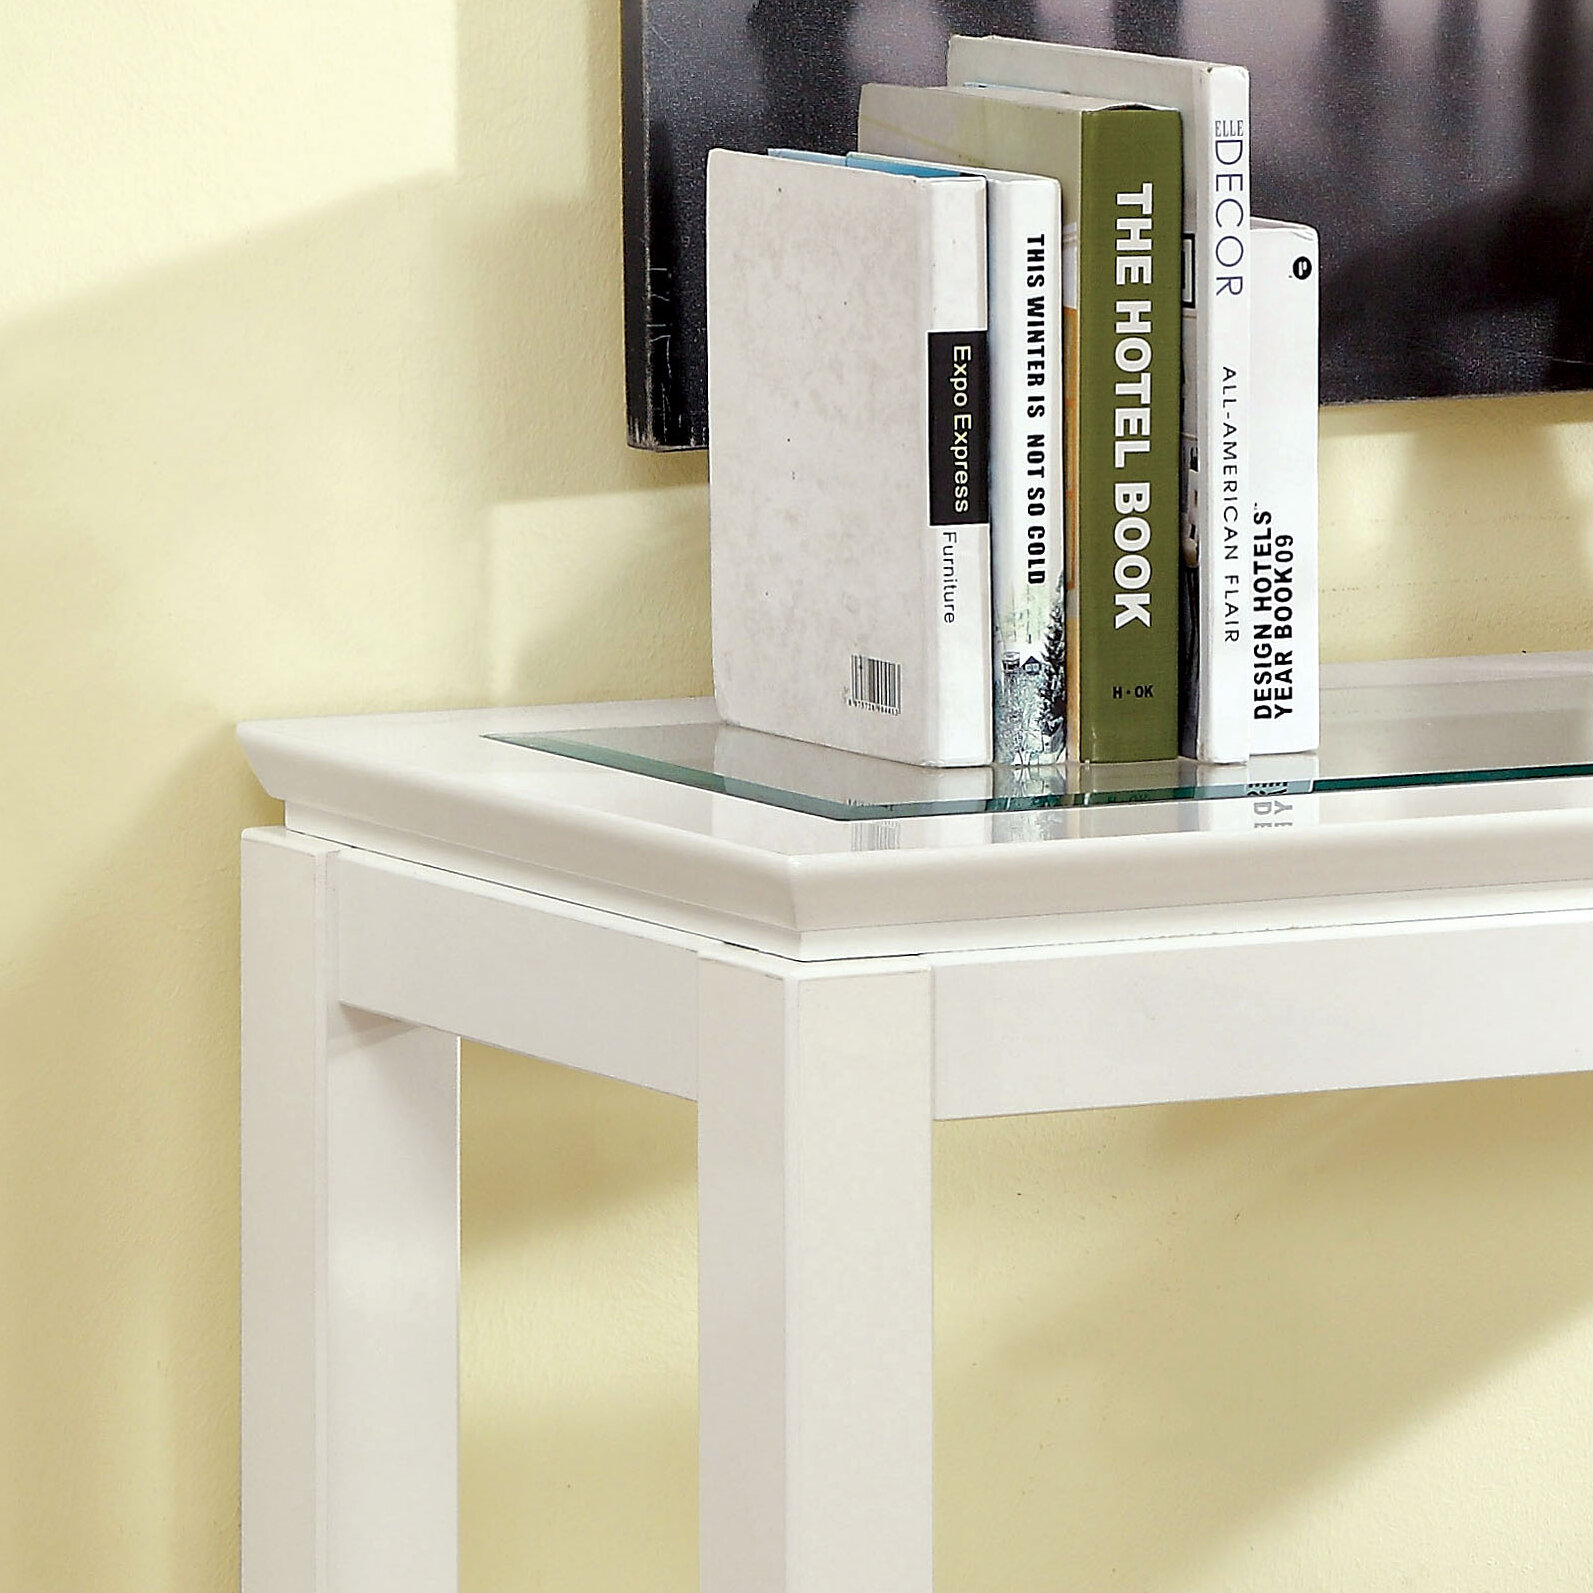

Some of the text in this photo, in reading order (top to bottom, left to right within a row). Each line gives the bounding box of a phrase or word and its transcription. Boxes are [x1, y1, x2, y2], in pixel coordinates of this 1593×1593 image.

[1214, 139, 1244, 296] DECOR
[1215, 119, 1244, 137] ELLE
[949, 345, 972, 513] Expo Express
[1026, 233, 1046, 585] THIS WINTER IS NOT SO COLD
[1114, 183, 1153, 629] THE HOTEL BOOK
[942, 531, 958, 624] Furniture
[1222, 366, 1240, 642] ALL-AMERICAN FLAIR
[1253, 511, 1273, 720] DESIGN HOTELS
[1273, 534, 1294, 720] YEAR BOOK09
